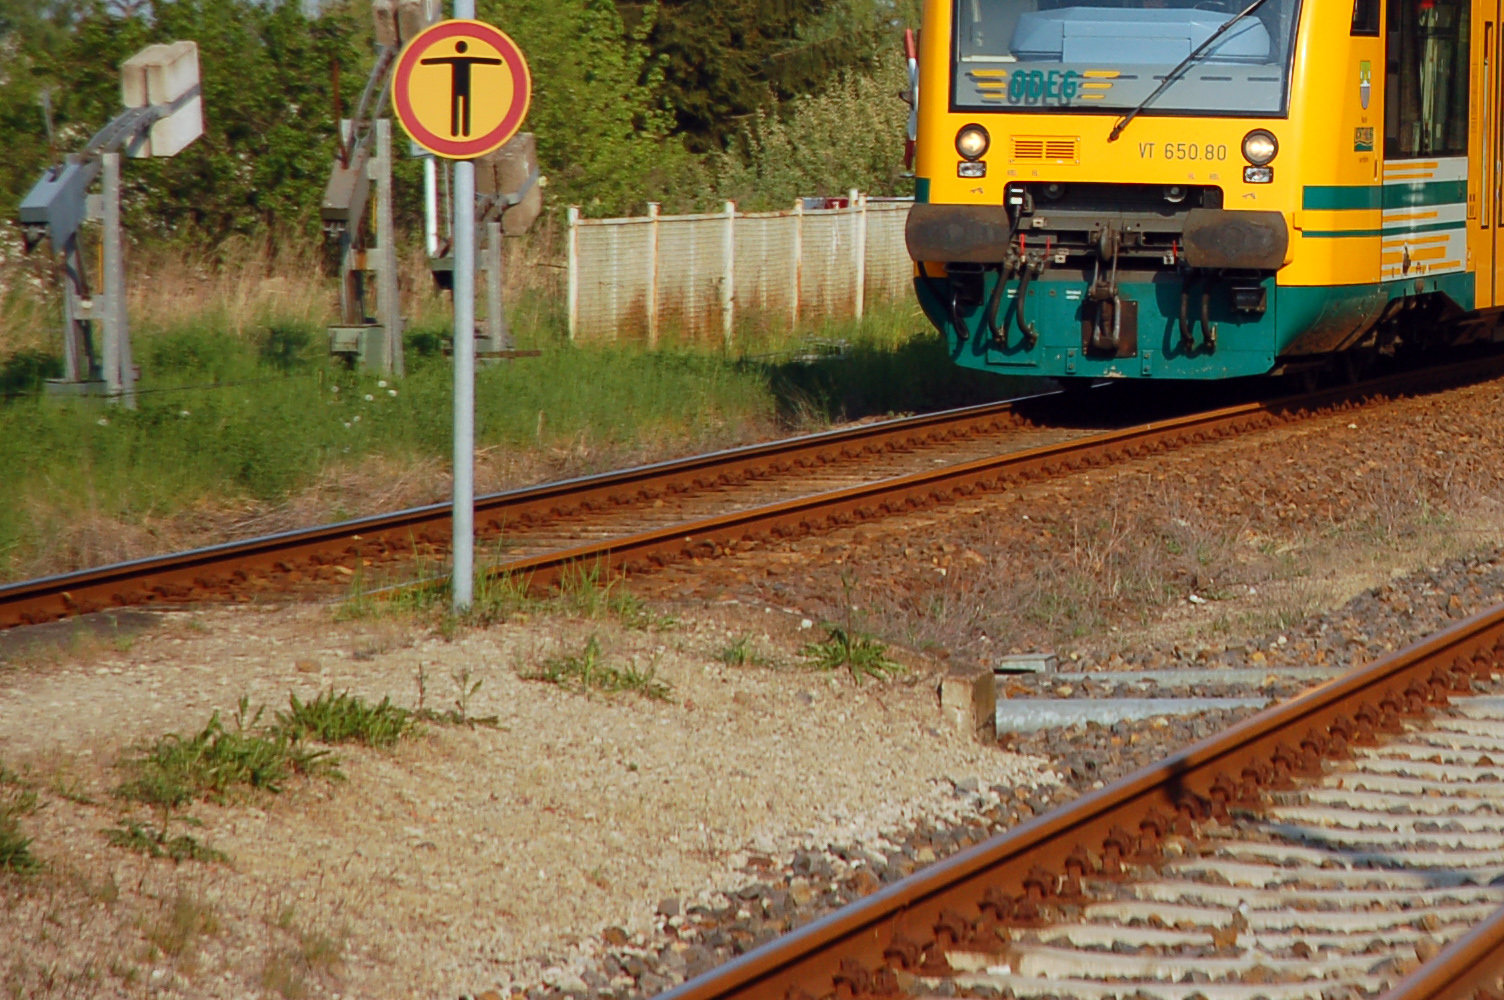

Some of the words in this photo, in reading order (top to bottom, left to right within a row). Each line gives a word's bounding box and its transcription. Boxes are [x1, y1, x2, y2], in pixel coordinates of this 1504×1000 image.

[1010, 69, 1078, 99] ODEG
[1138, 142, 1156, 159] VT
[1164, 143, 1227, 161] 650.80
